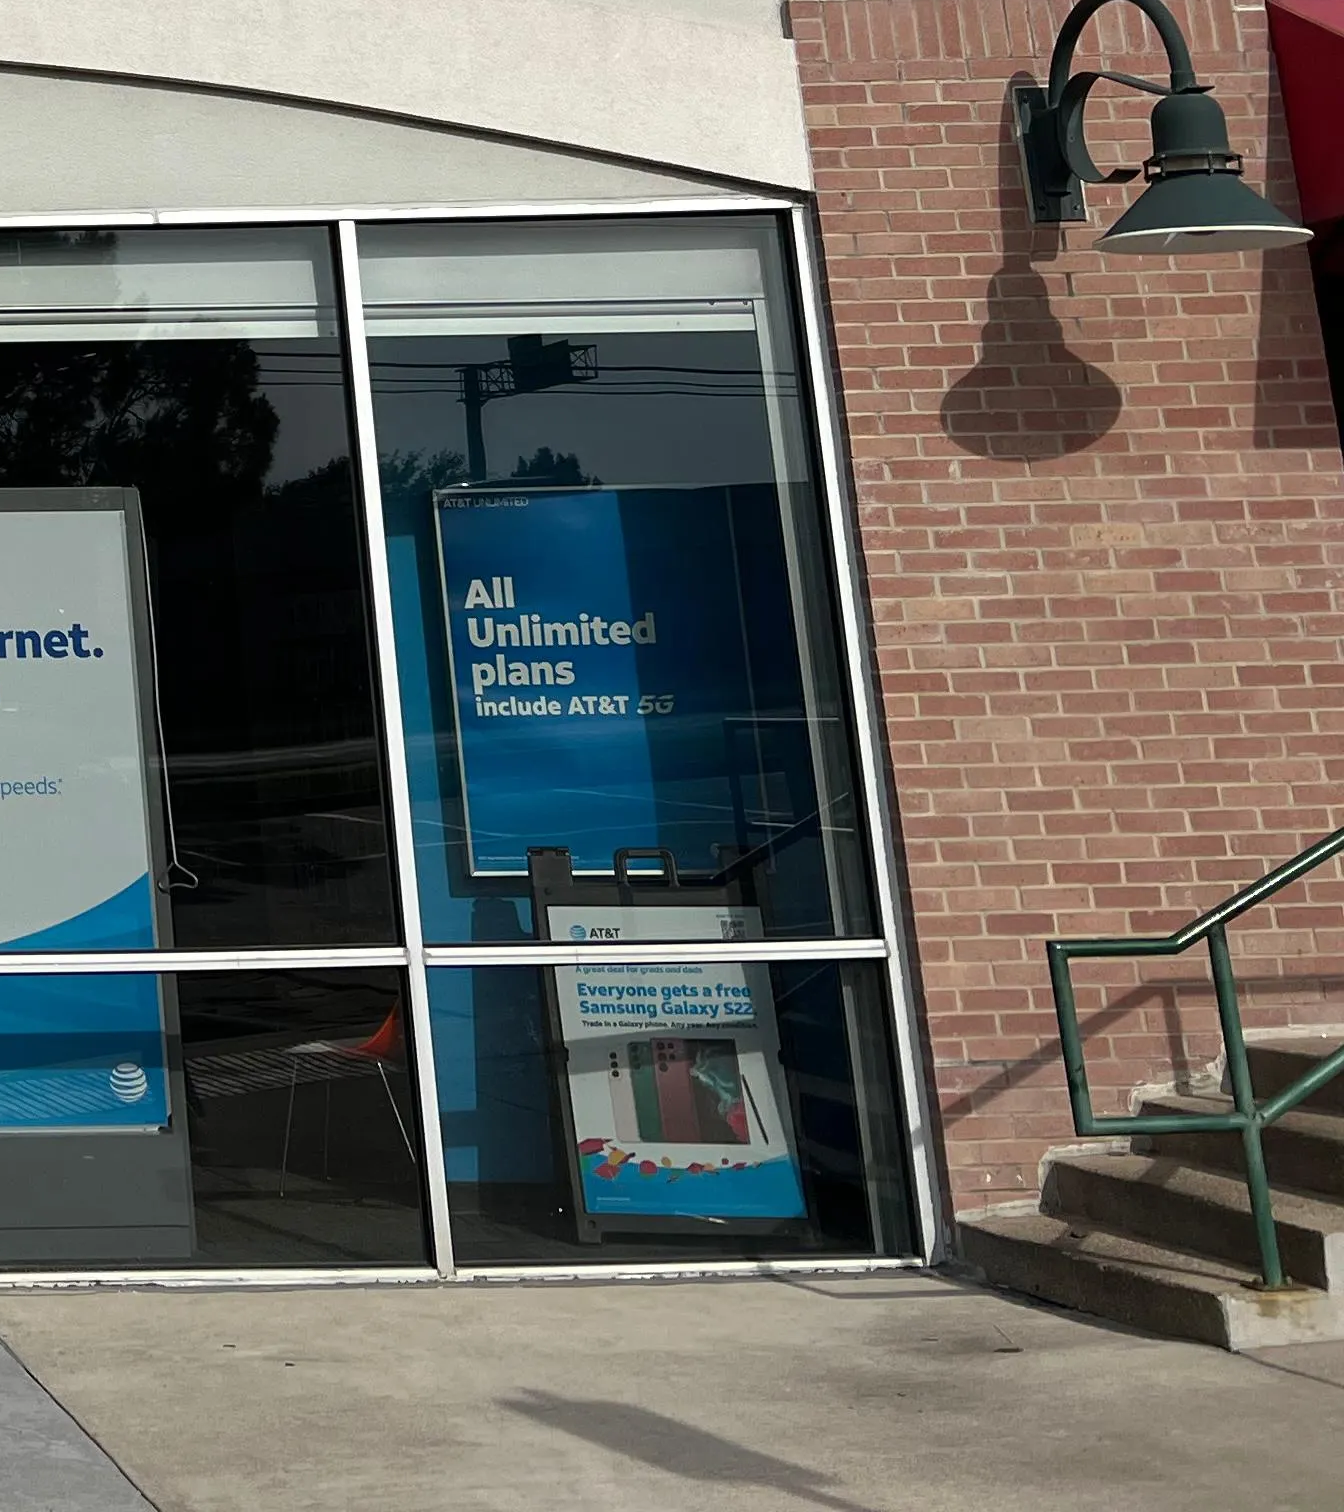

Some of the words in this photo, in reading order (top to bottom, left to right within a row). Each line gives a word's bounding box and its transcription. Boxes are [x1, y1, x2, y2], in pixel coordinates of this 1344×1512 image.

[443, 497, 471, 508] AT&T
[473, 496, 529, 507] UNLIMITED
[464, 576, 515, 609] All
[467, 612, 656, 648] Unlimited
[472, 654, 575, 695] plans
[475, 694, 561, 717] include
[568, 696, 629, 716] AT&T
[637, 695, 675, 715] 5G
[589, 927, 620, 939] AT&T
[581, 966, 605, 975] great
[607, 965, 625, 973] deal
[640, 966, 664, 975] grads
[577, 983, 657, 1001] Everyone
[661, 984, 698, 1000] gets
[703, 987, 712, 997] a
[716, 983, 751, 998] free
[580, 1000, 657, 1018] Samsung
[662, 1000, 719, 1018] Galaxy
[582, 1020, 603, 1028] Trade
[619, 1020, 643, 1029] Galaxy
[670, 1021, 685, 1029] Any
